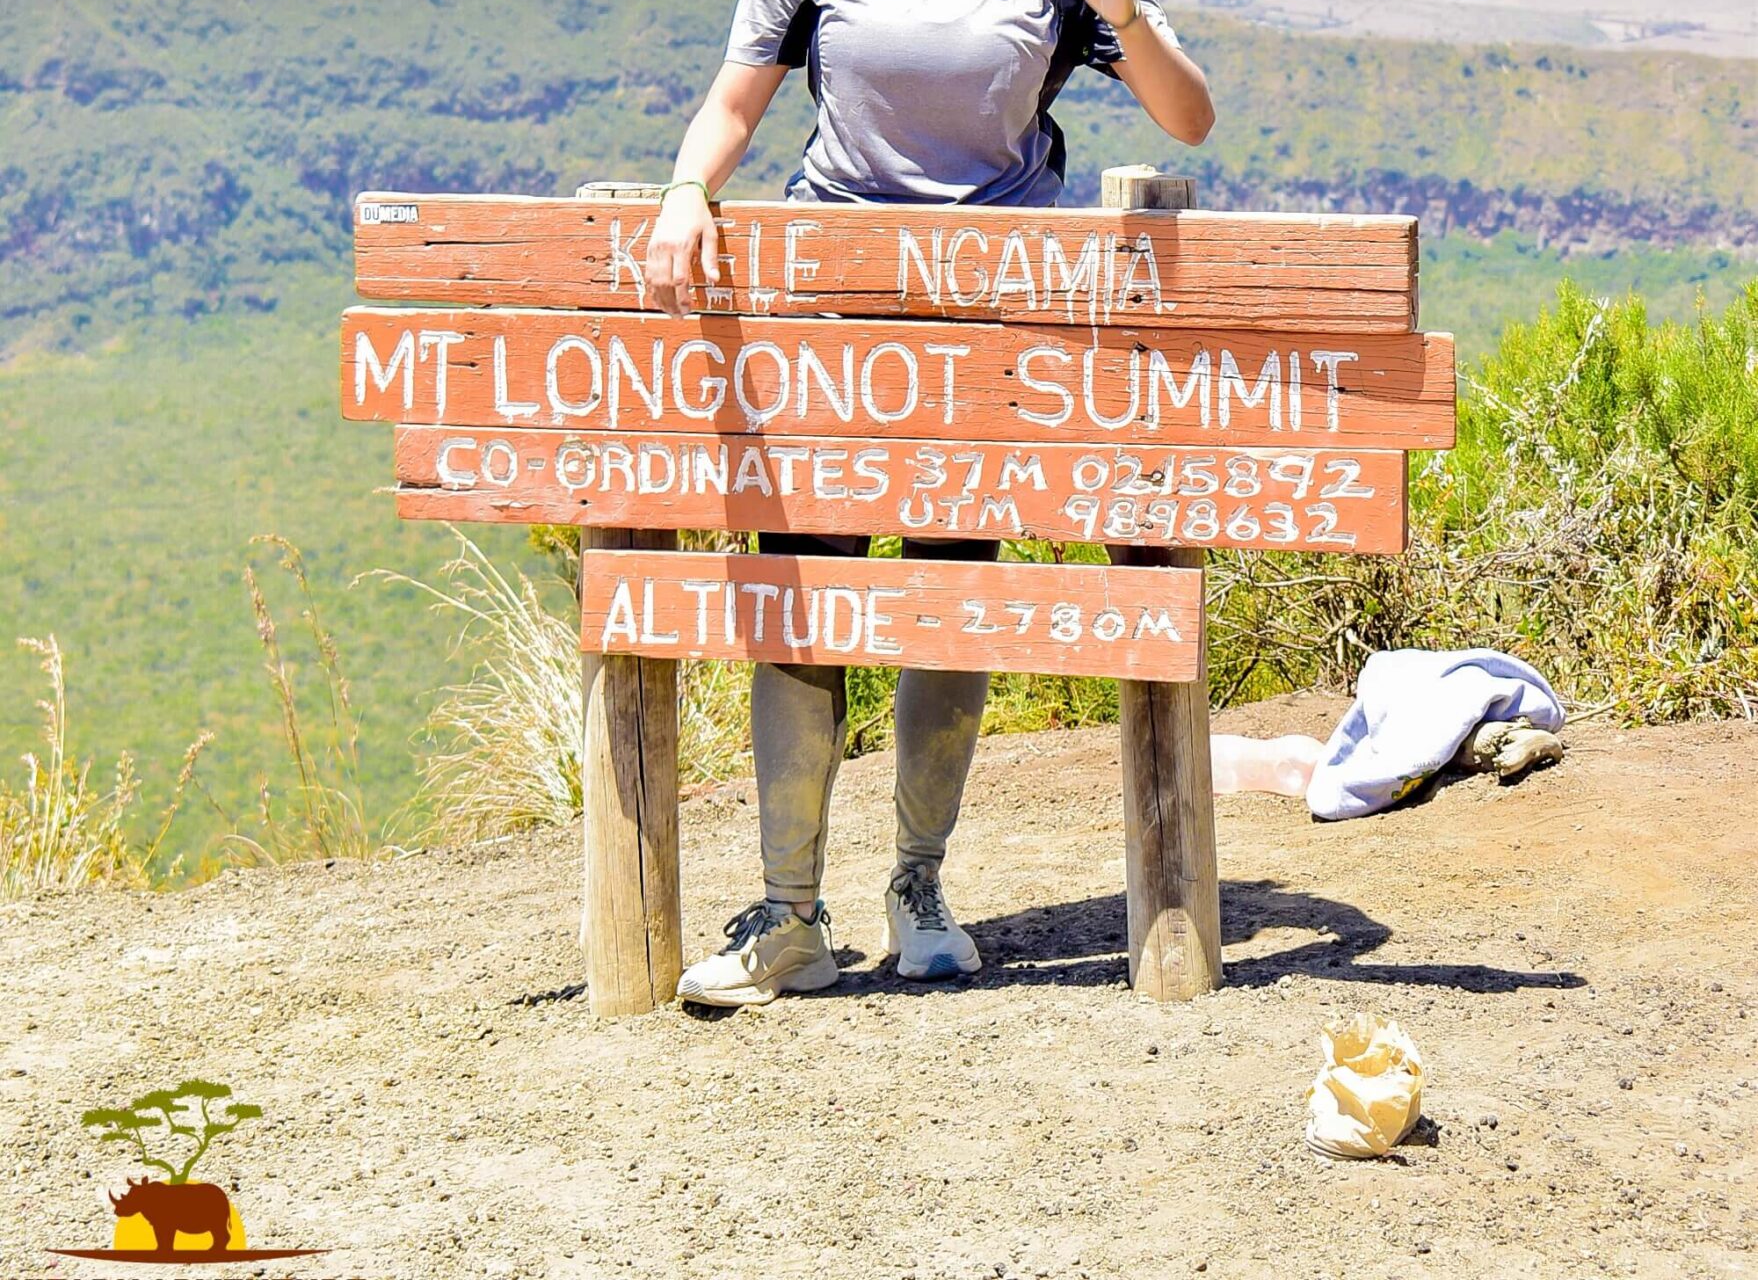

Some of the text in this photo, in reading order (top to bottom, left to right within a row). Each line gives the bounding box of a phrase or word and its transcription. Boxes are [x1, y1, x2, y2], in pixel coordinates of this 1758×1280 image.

[355, 329, 1359, 433] MT LONGONOT SUMMIT
[437, 437, 890, 500] CO-ORDINATES
[899, 494, 1357, 544] UTM 9898632
[602, 577, 904, 654] ALTITUDE
